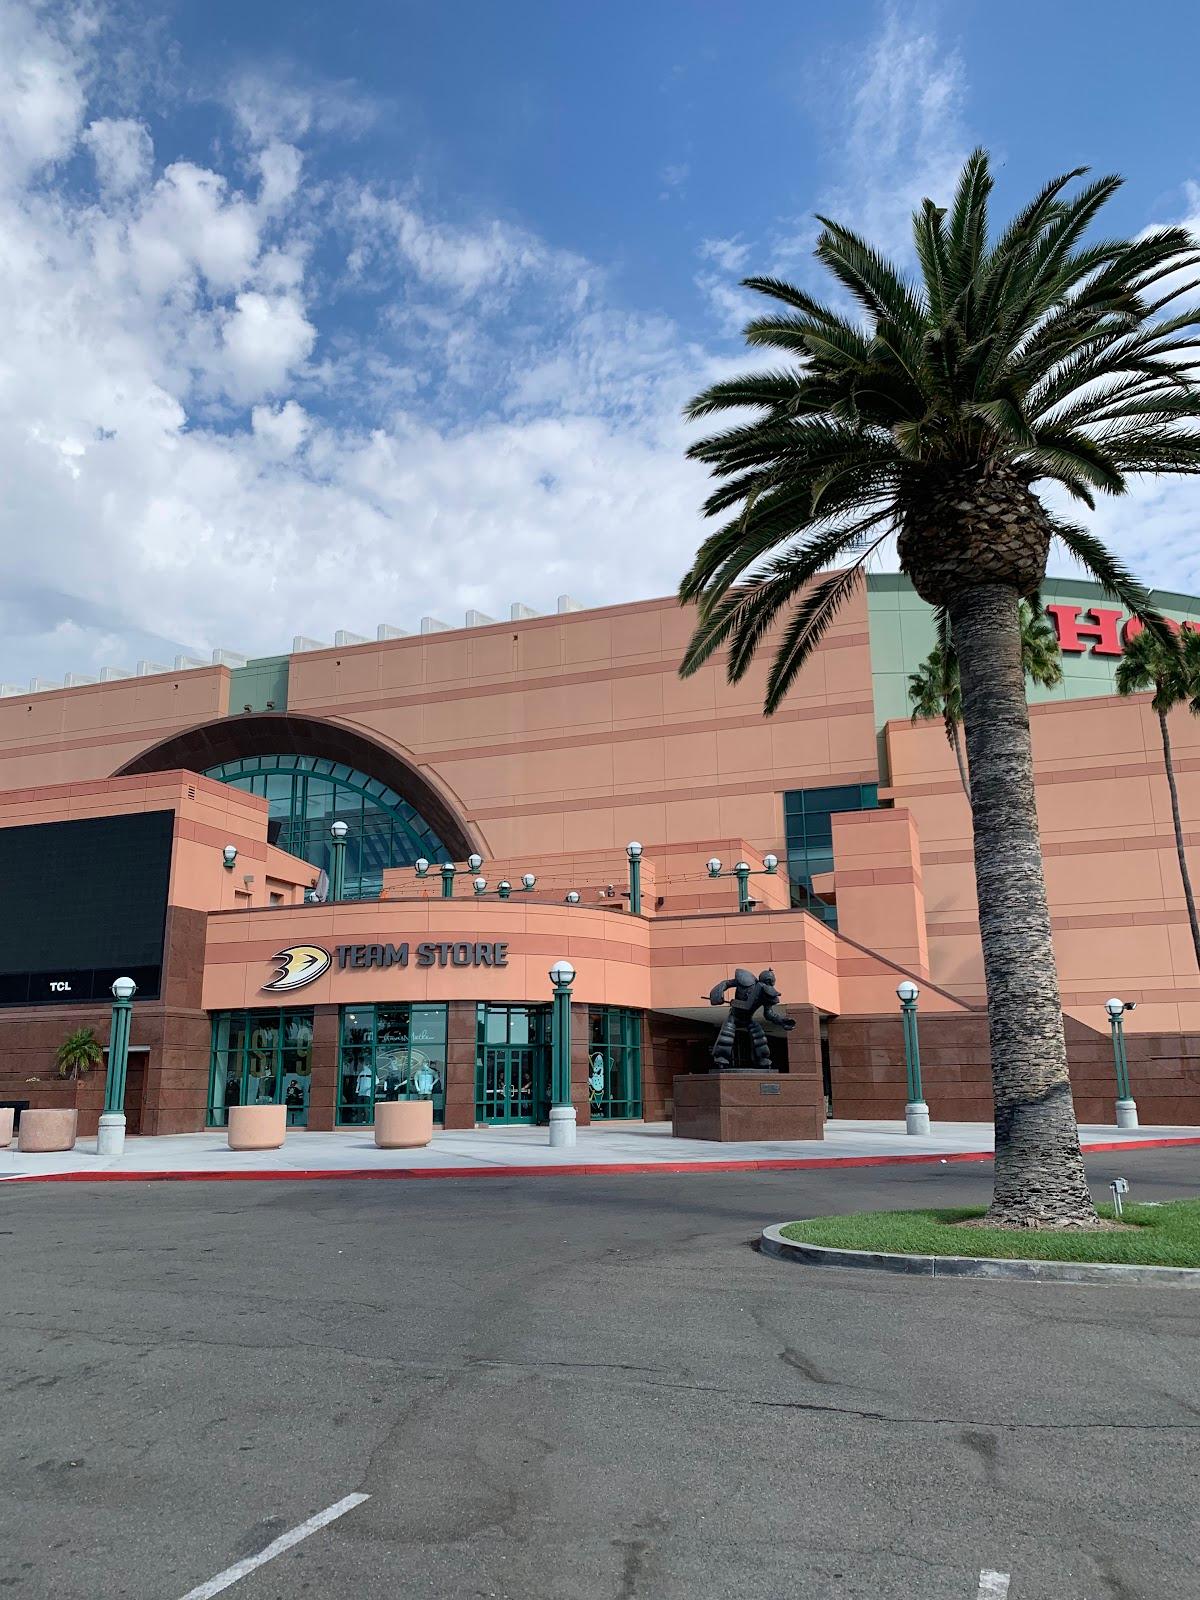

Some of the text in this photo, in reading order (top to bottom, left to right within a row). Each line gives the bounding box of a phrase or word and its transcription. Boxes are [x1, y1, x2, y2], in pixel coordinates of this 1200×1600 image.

[335, 941, 508, 968] TEAM STORE
[49, 981, 72, 992] TCL
